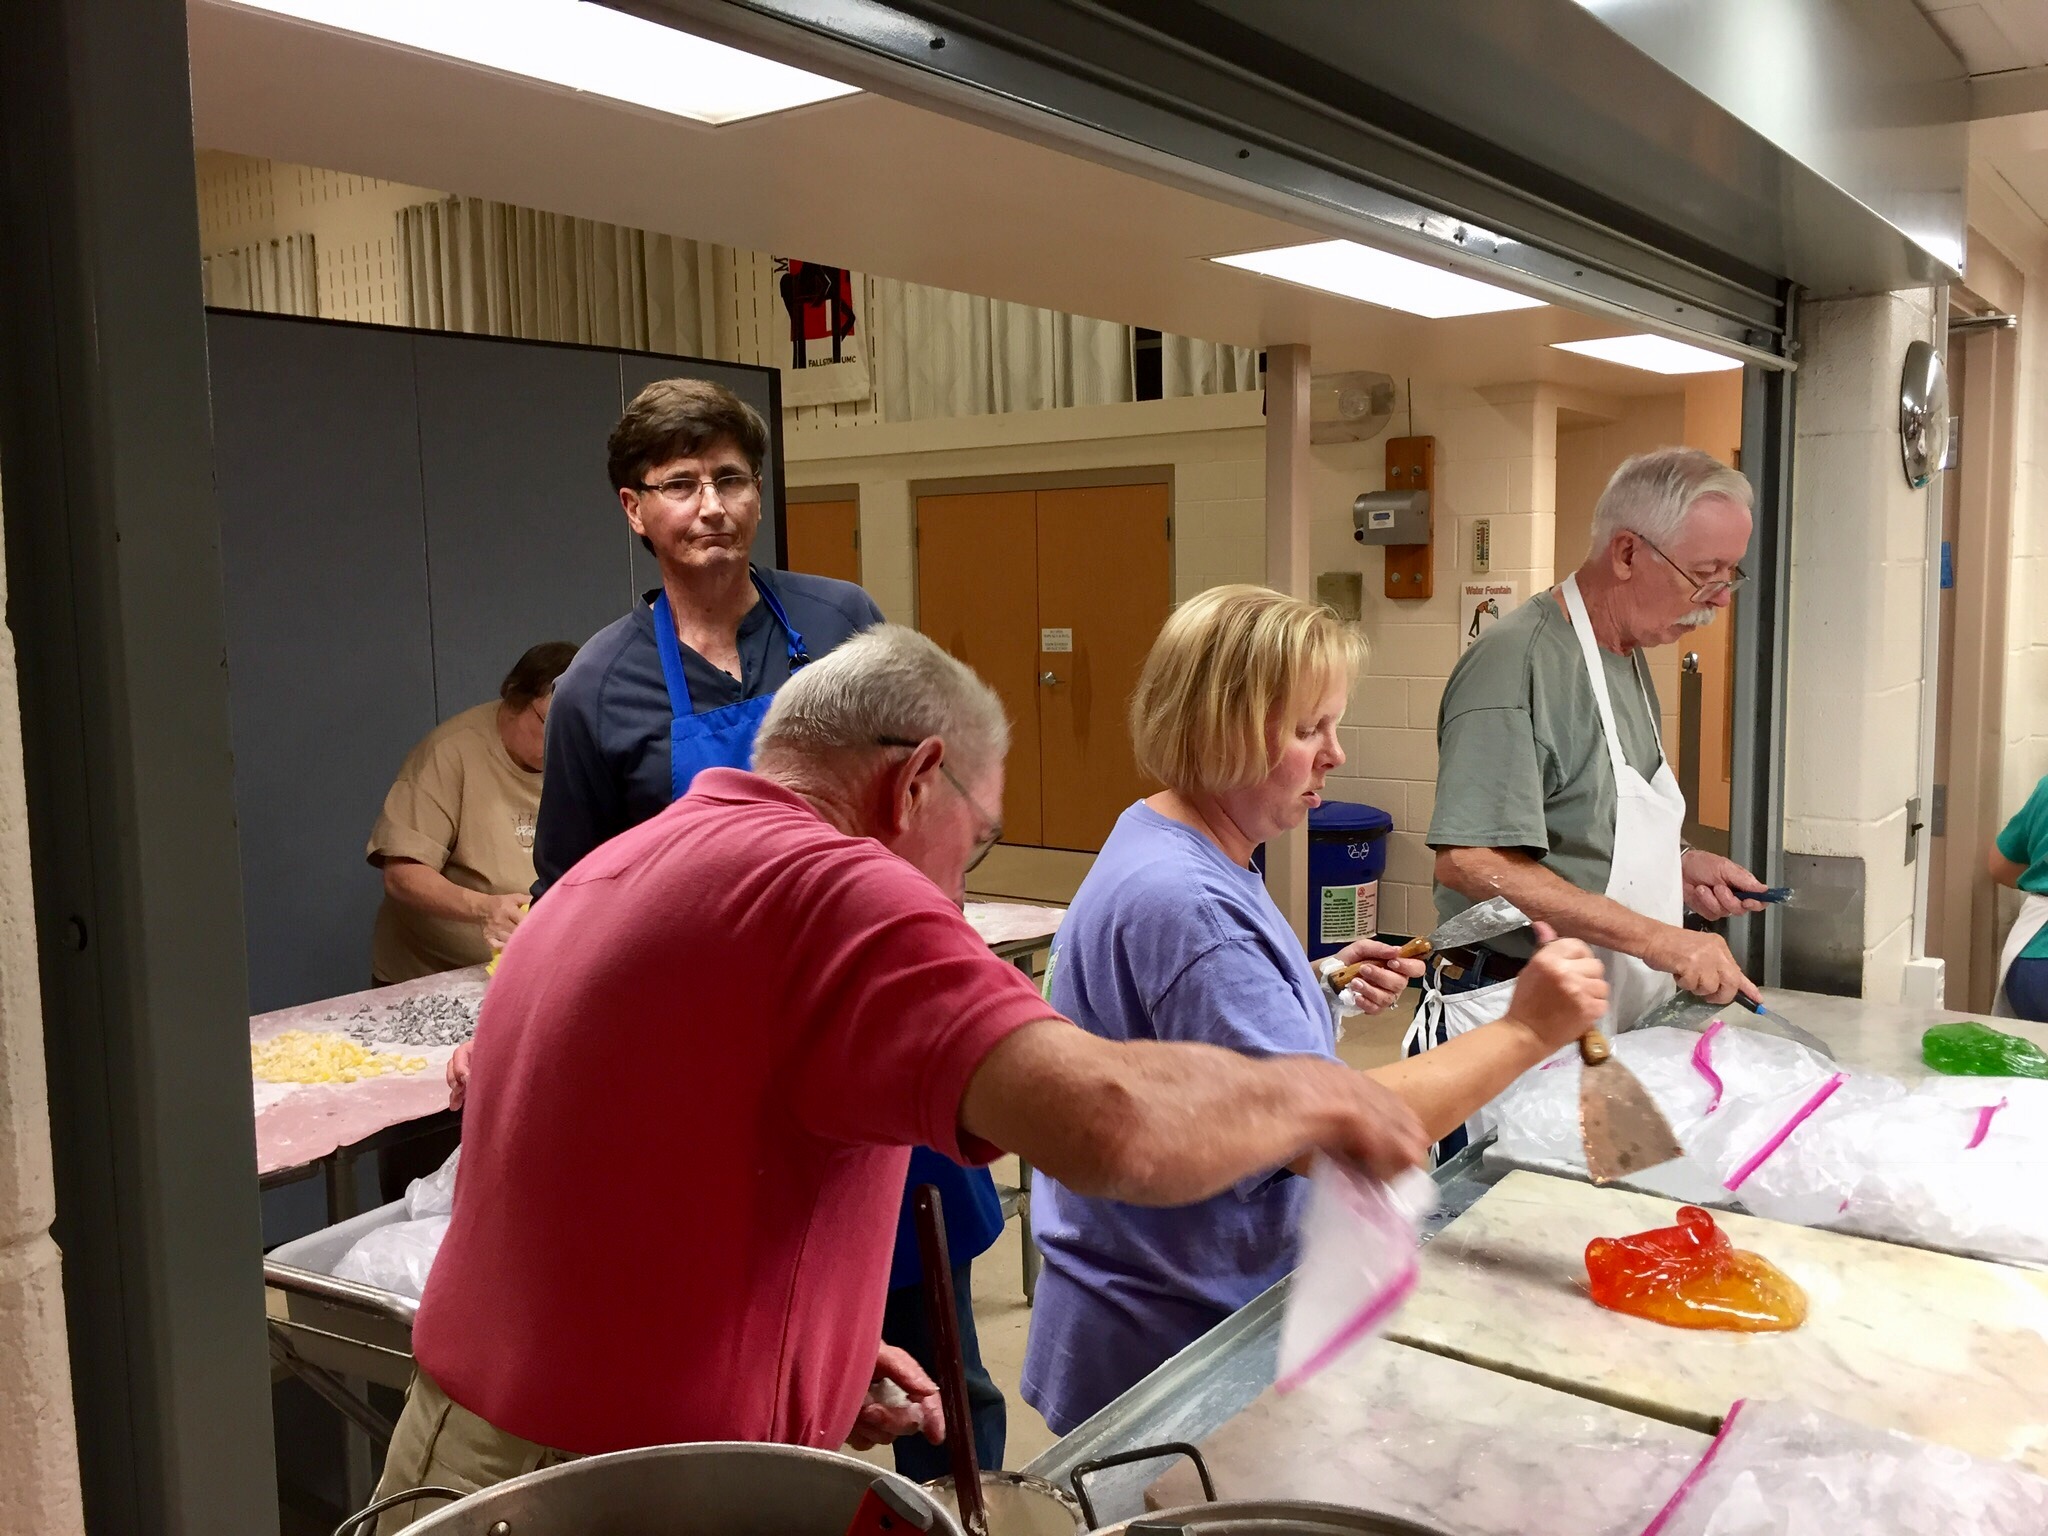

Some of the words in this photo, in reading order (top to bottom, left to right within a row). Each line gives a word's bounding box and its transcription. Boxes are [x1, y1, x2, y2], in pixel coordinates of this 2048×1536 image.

[841, 355, 857, 364] UMC
[1465, 585, 1484, 595] Water
[1485, 585, 1512, 595] Fountain
